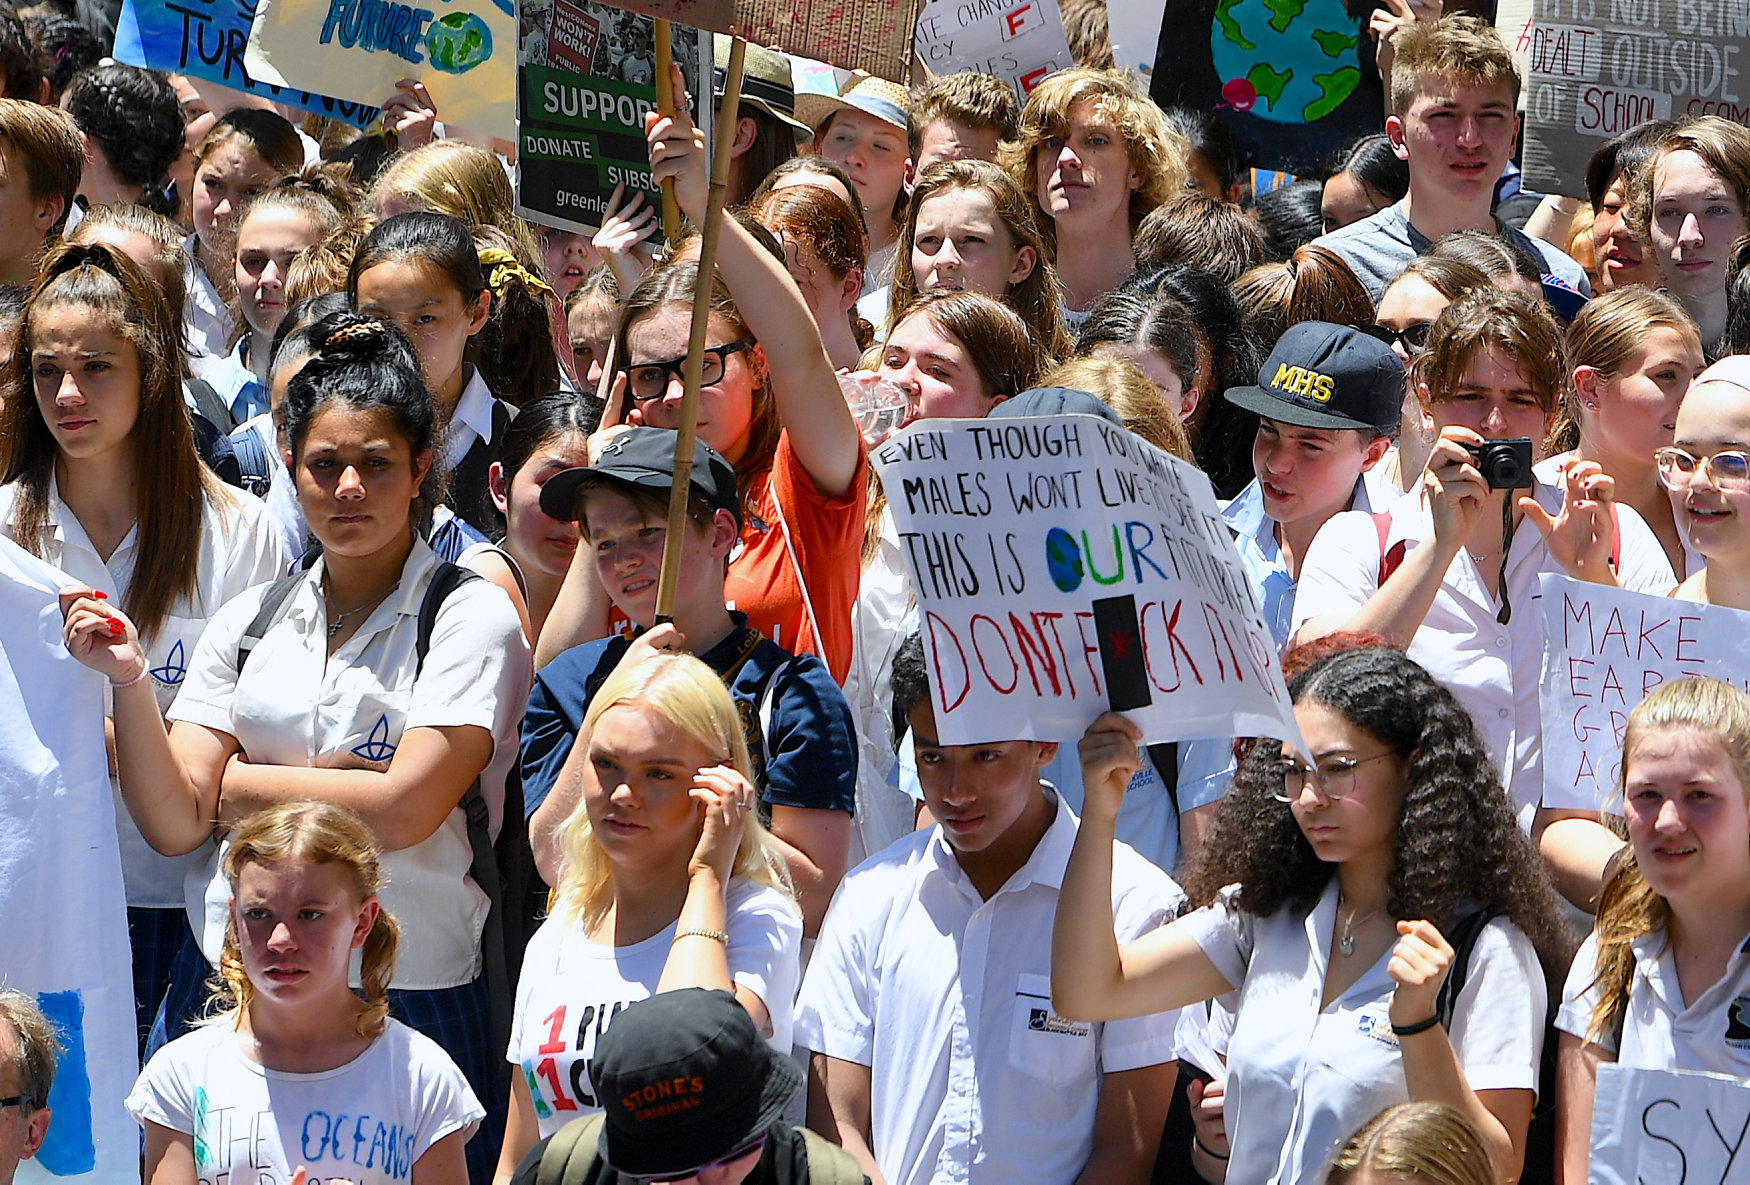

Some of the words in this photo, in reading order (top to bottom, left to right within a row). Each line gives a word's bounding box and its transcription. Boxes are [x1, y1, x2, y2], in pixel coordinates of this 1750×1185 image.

[553, 26, 592, 59] WORK!
[556, 15, 596, 46] WON'T
[555, 53, 581, 75] PUBLIC
[1531, 26, 1595, 77] DEALT
[1610, 34, 1741, 104] OUTSIDE
[1535, 83, 1569, 124] OF
[1580, 86, 1658, 134] SCHOOL
[526, 134, 595, 162] DONATE
[1270, 362, 1336, 405] MHS
[878, 429, 949, 467] EVEN
[966, 423, 1083, 462] THOUGH
[1097, 423, 1140, 466] YOU
[902, 470, 993, 519] MALES
[1095, 468, 1151, 507] LIVE
[899, 530, 981, 602] THIS
[990, 530, 1027, 597] IS
[1563, 591, 1705, 664] MAKE
[1126, 776, 1155, 793] SCHOOL
[538, 1004, 567, 1055] 1
[536, 1057, 579, 1112] 1
[621, 1074, 706, 1113] STONE'S
[634, 1095, 701, 1122] ORIGINAL
[207, 1105, 279, 1170] THE
[300, 1109, 416, 1181] OCEANS
